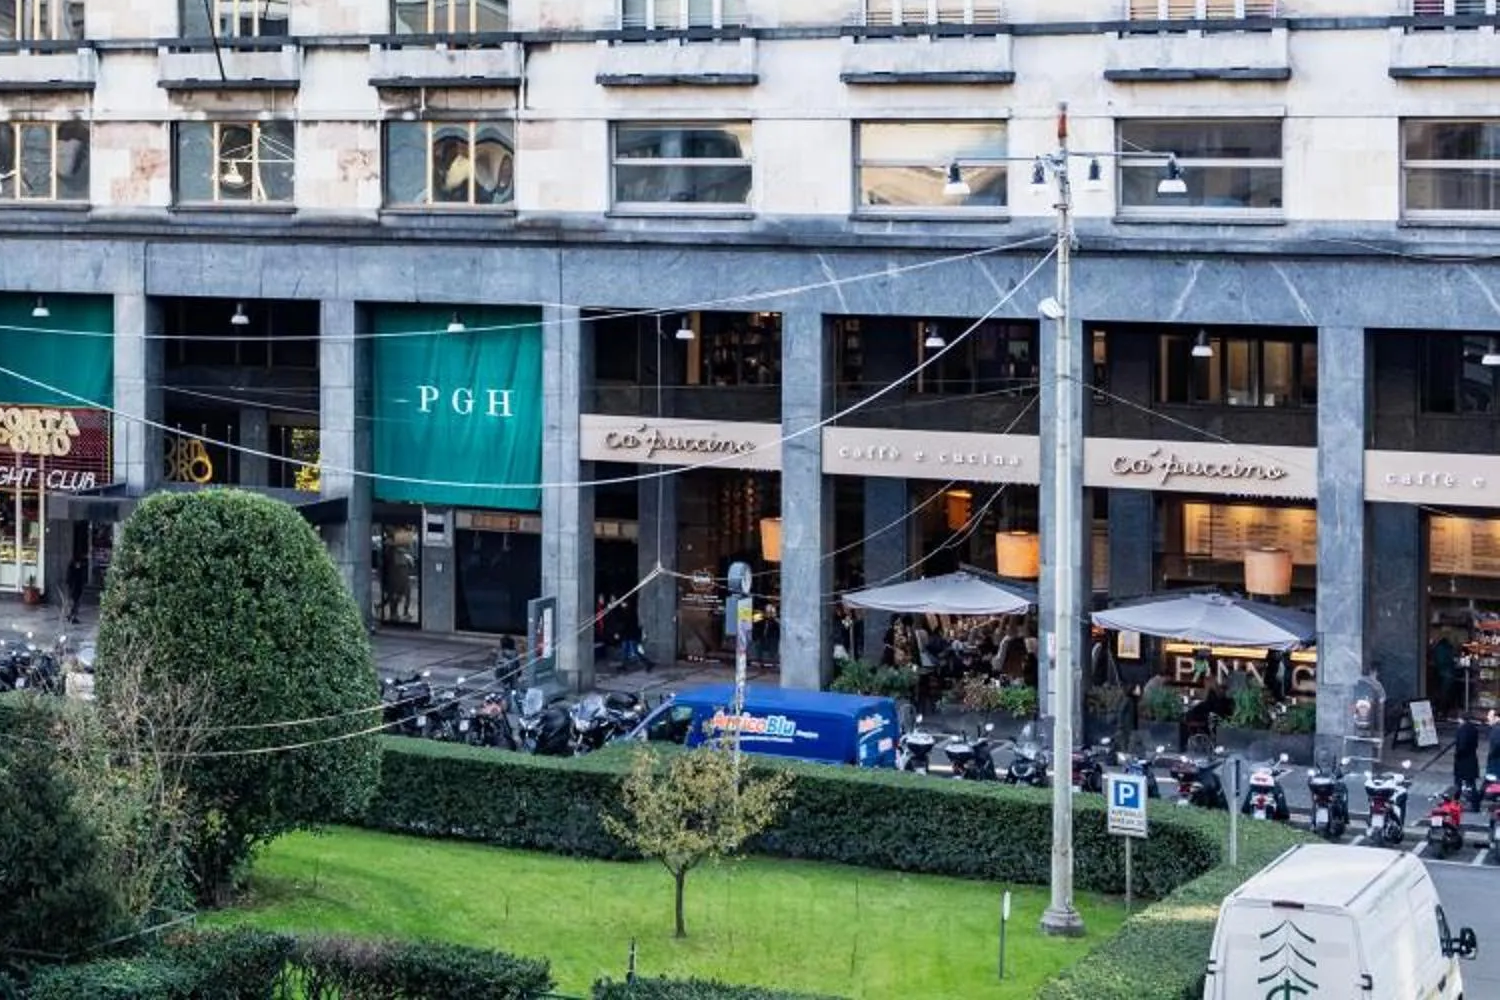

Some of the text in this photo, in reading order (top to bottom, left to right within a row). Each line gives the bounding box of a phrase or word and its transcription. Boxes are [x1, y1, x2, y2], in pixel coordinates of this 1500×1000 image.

[939, 451, 1022, 467] cucina
[47, 469, 95, 489] CLUB
[1118, 783, 1135, 805] P
